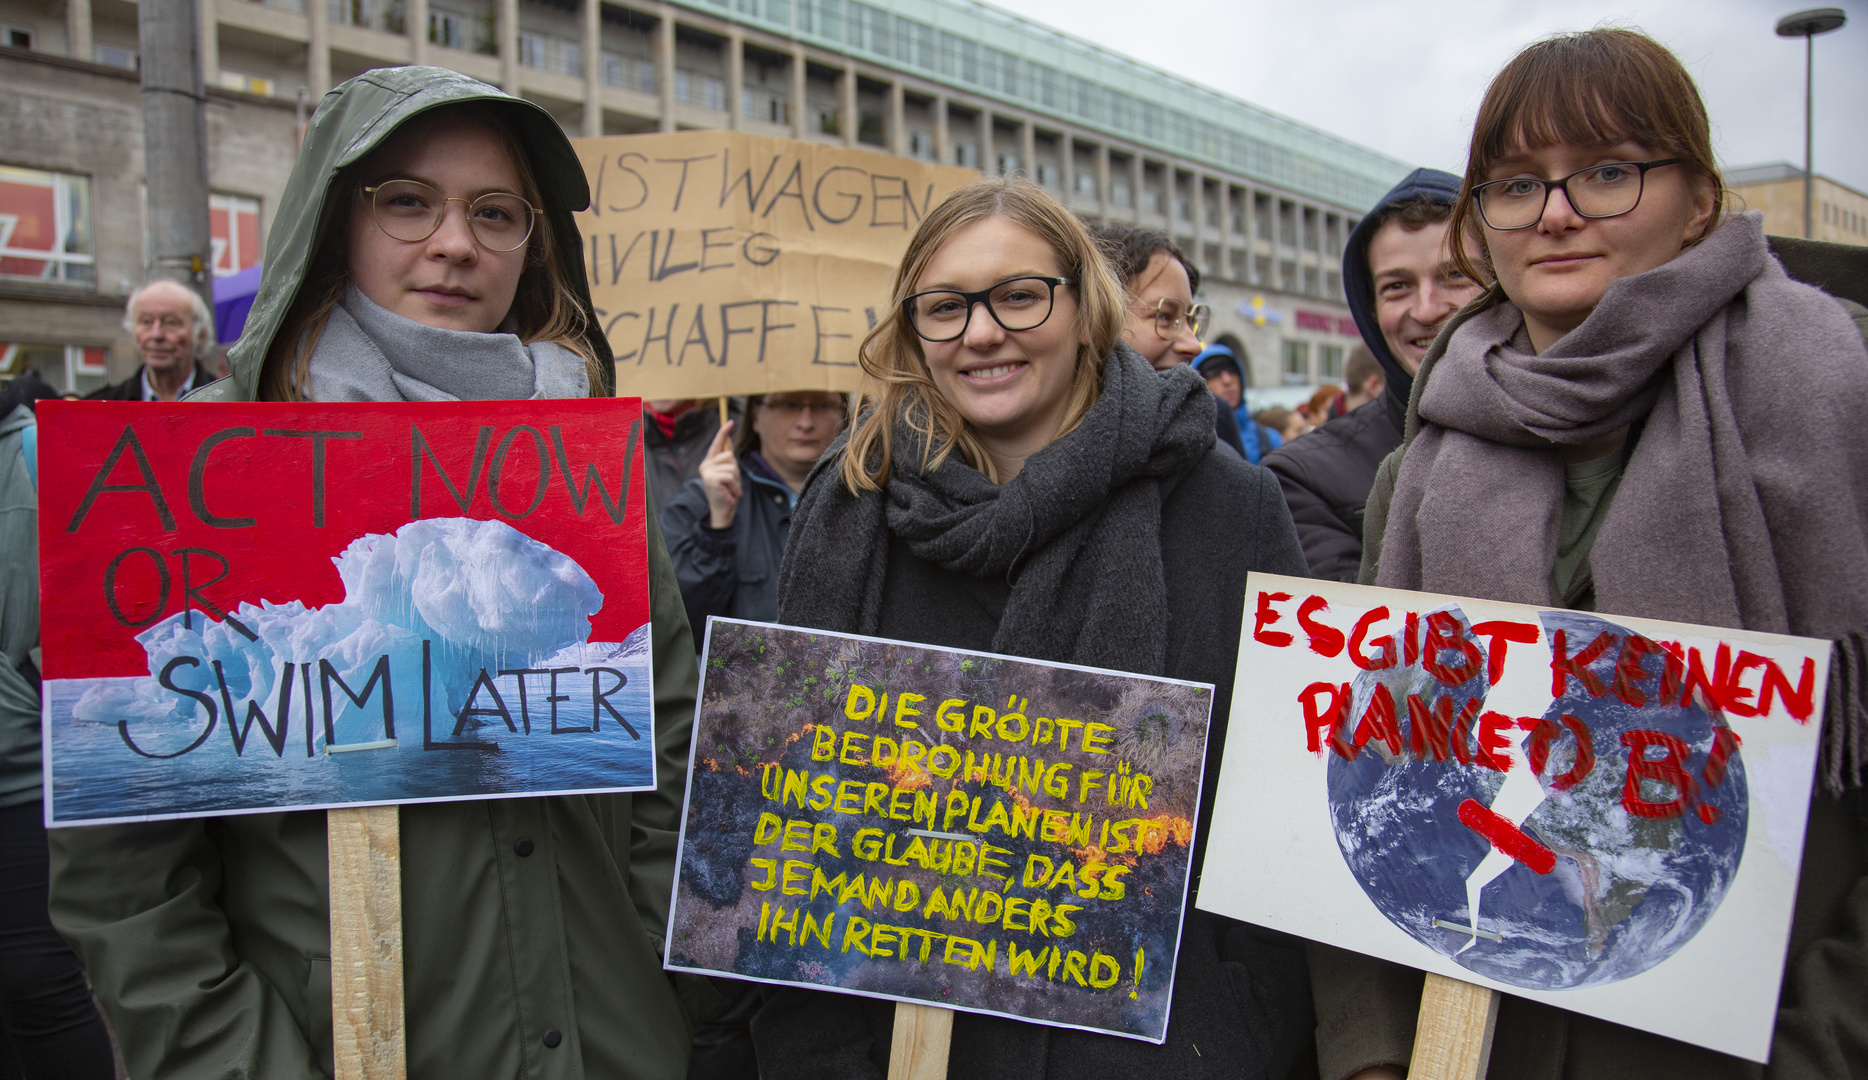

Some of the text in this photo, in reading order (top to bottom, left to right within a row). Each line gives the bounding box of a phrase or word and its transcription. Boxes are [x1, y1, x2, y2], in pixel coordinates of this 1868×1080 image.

[66, 419, 641, 532] ACT NOW
[104, 547, 259, 640] OR
[118, 640, 640, 758] SWIM LATER
[1253, 591, 1815, 725] ES GIBT KEINEN
[845, 684, 926, 729] DIE
[762, 764, 1164, 856] UNSEREN PLANEN IST
[812, 724, 1152, 810] BEDROHUNG FÜR
[1620, 726, 1742, 825] B!
[751, 858, 1084, 938] JEMAND ANDERS
[754, 812, 1132, 900] DER GLAUBE, DASS
[757, 901, 835, 949] IHN
[841, 916, 997, 973] RETTEN
